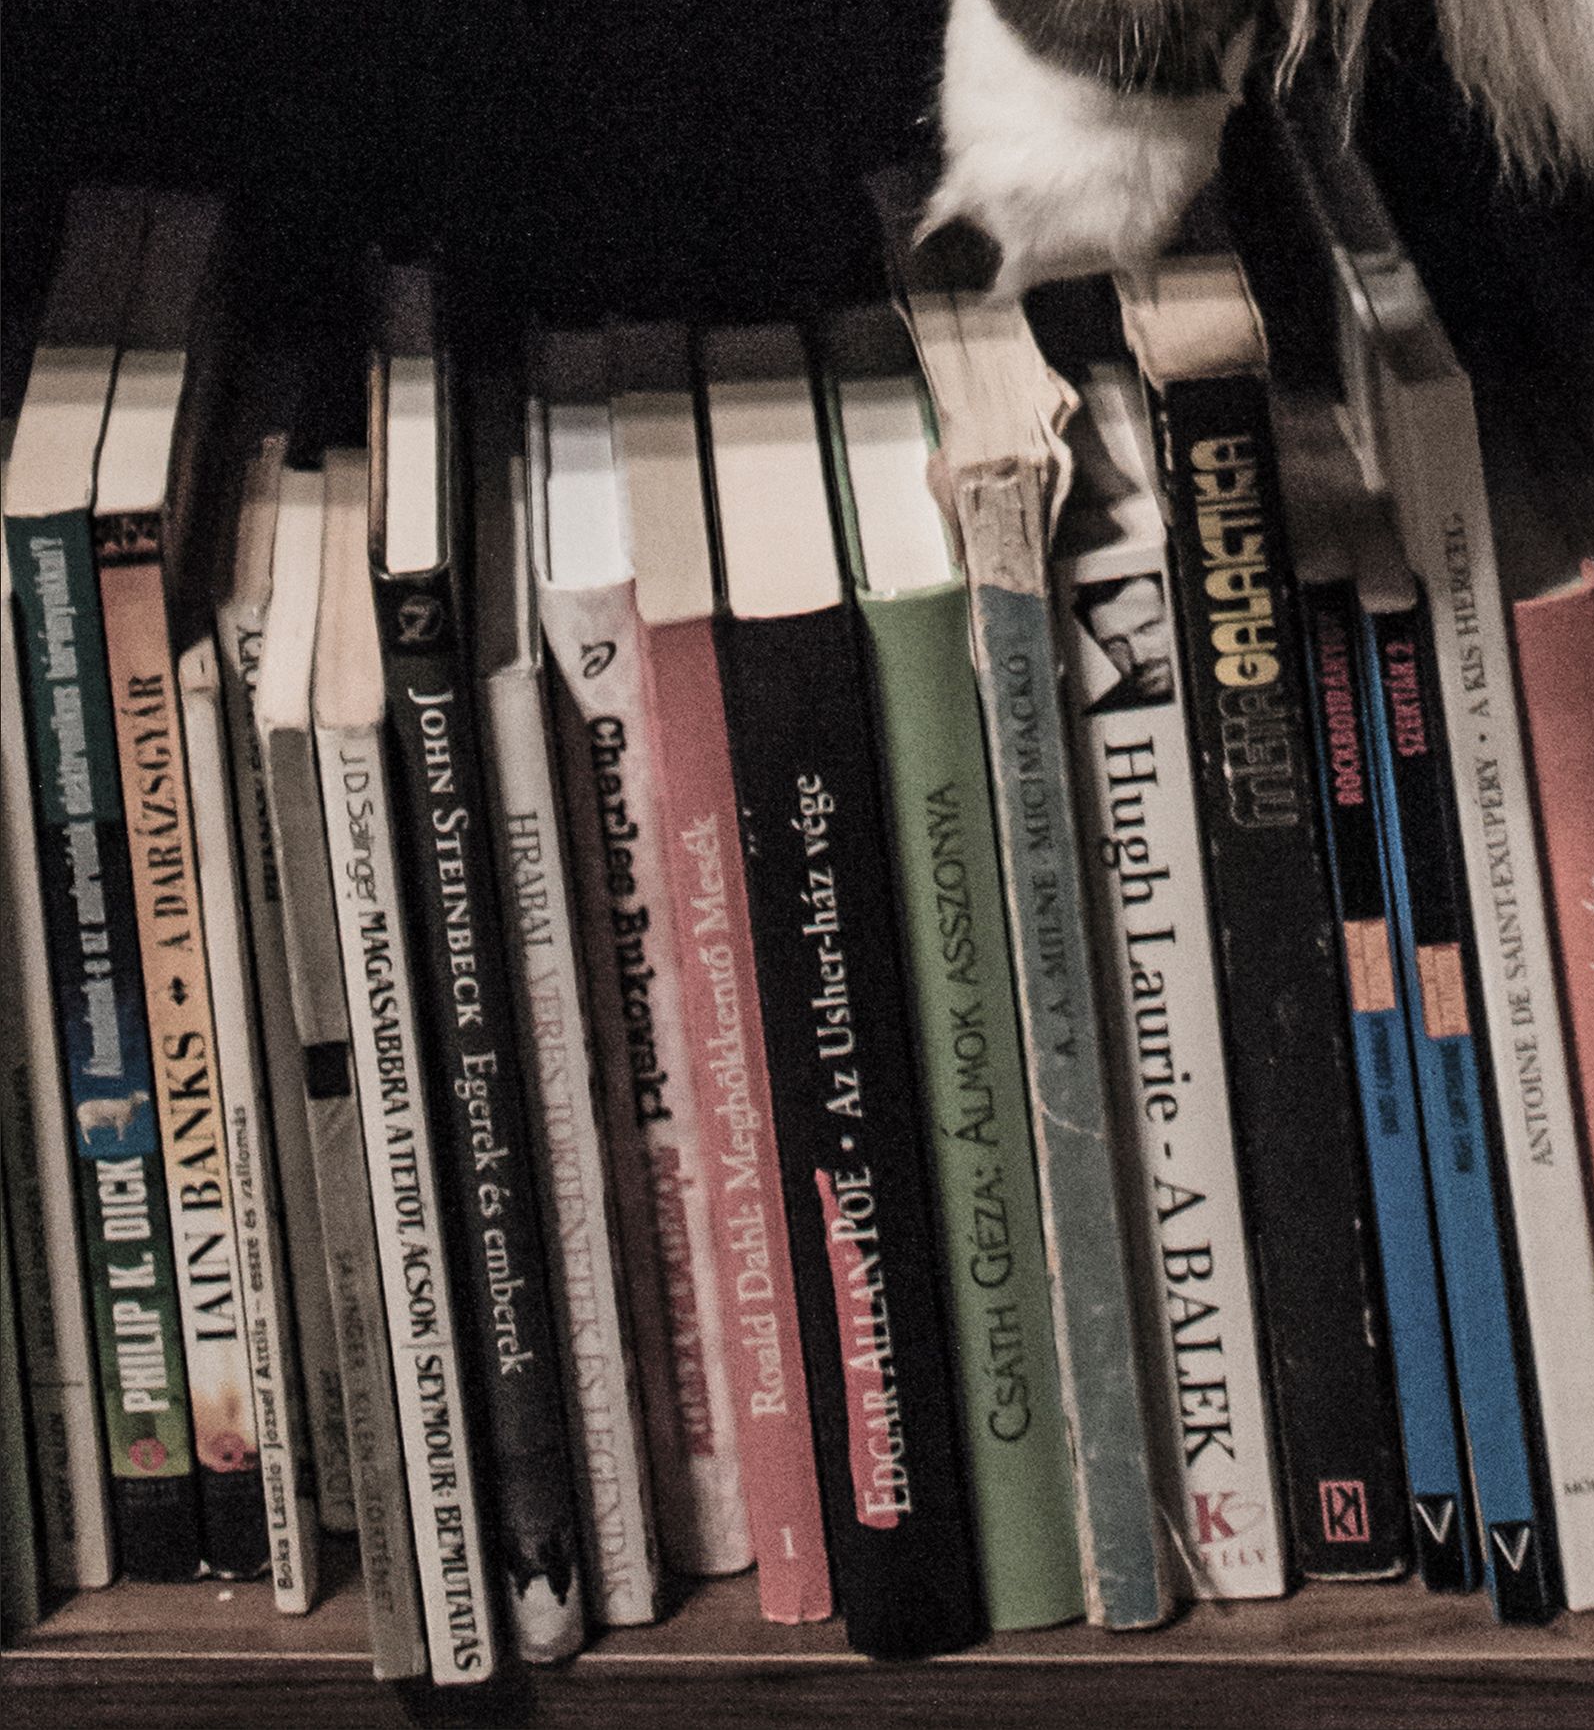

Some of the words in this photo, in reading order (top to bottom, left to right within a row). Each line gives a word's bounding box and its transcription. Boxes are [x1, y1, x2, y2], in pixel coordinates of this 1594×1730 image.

[126, 673, 189, 920] DARÁZSGYÁR
[408, 687, 456, 797] JOHN
[589, 714, 640, 896] Charles
[505, 811, 555, 955] HRABAL
[791, 772, 837, 859] vége
[925, 781, 980, 990] ASSZONYA
[1102, 736, 1171, 902] Hugh
[1474, 755, 1532, 989] SAINT-EXUPÉRY
[431, 804, 482, 1029] STEINBECK
[802, 863, 859, 1061] Usher-ház
[612, 908, 673, 1128] Bukowski
[1126, 923, 1193, 1125] Laurie
[162, 1028, 225, 1224] BANKS
[456, 1050, 510, 1172] Egerek
[1512, 1034, 1556, 1167] ANTOINE
[97, 1154, 151, 1243] DICK
[359, 907, 411, 1116] MAGASABBRA
[413, 1354, 460, 1498] SEYMOUR:
[832, 1165, 879, 1244] POE
[964, 1166, 1013, 1290] GÉZA:
[113, 1300, 171, 1414] PHILIP
[186, 1231, 239, 1345] IAIN
[483, 1227, 538, 1377] emberek
[848, 1253, 898, 1390] ALLAN
[1163, 1246, 1237, 1468] BALEK
[737, 1310, 787, 1417] Roald
[986, 1303, 1033, 1443] CSÁTH
[863, 1394, 914, 1518] EDGAR
